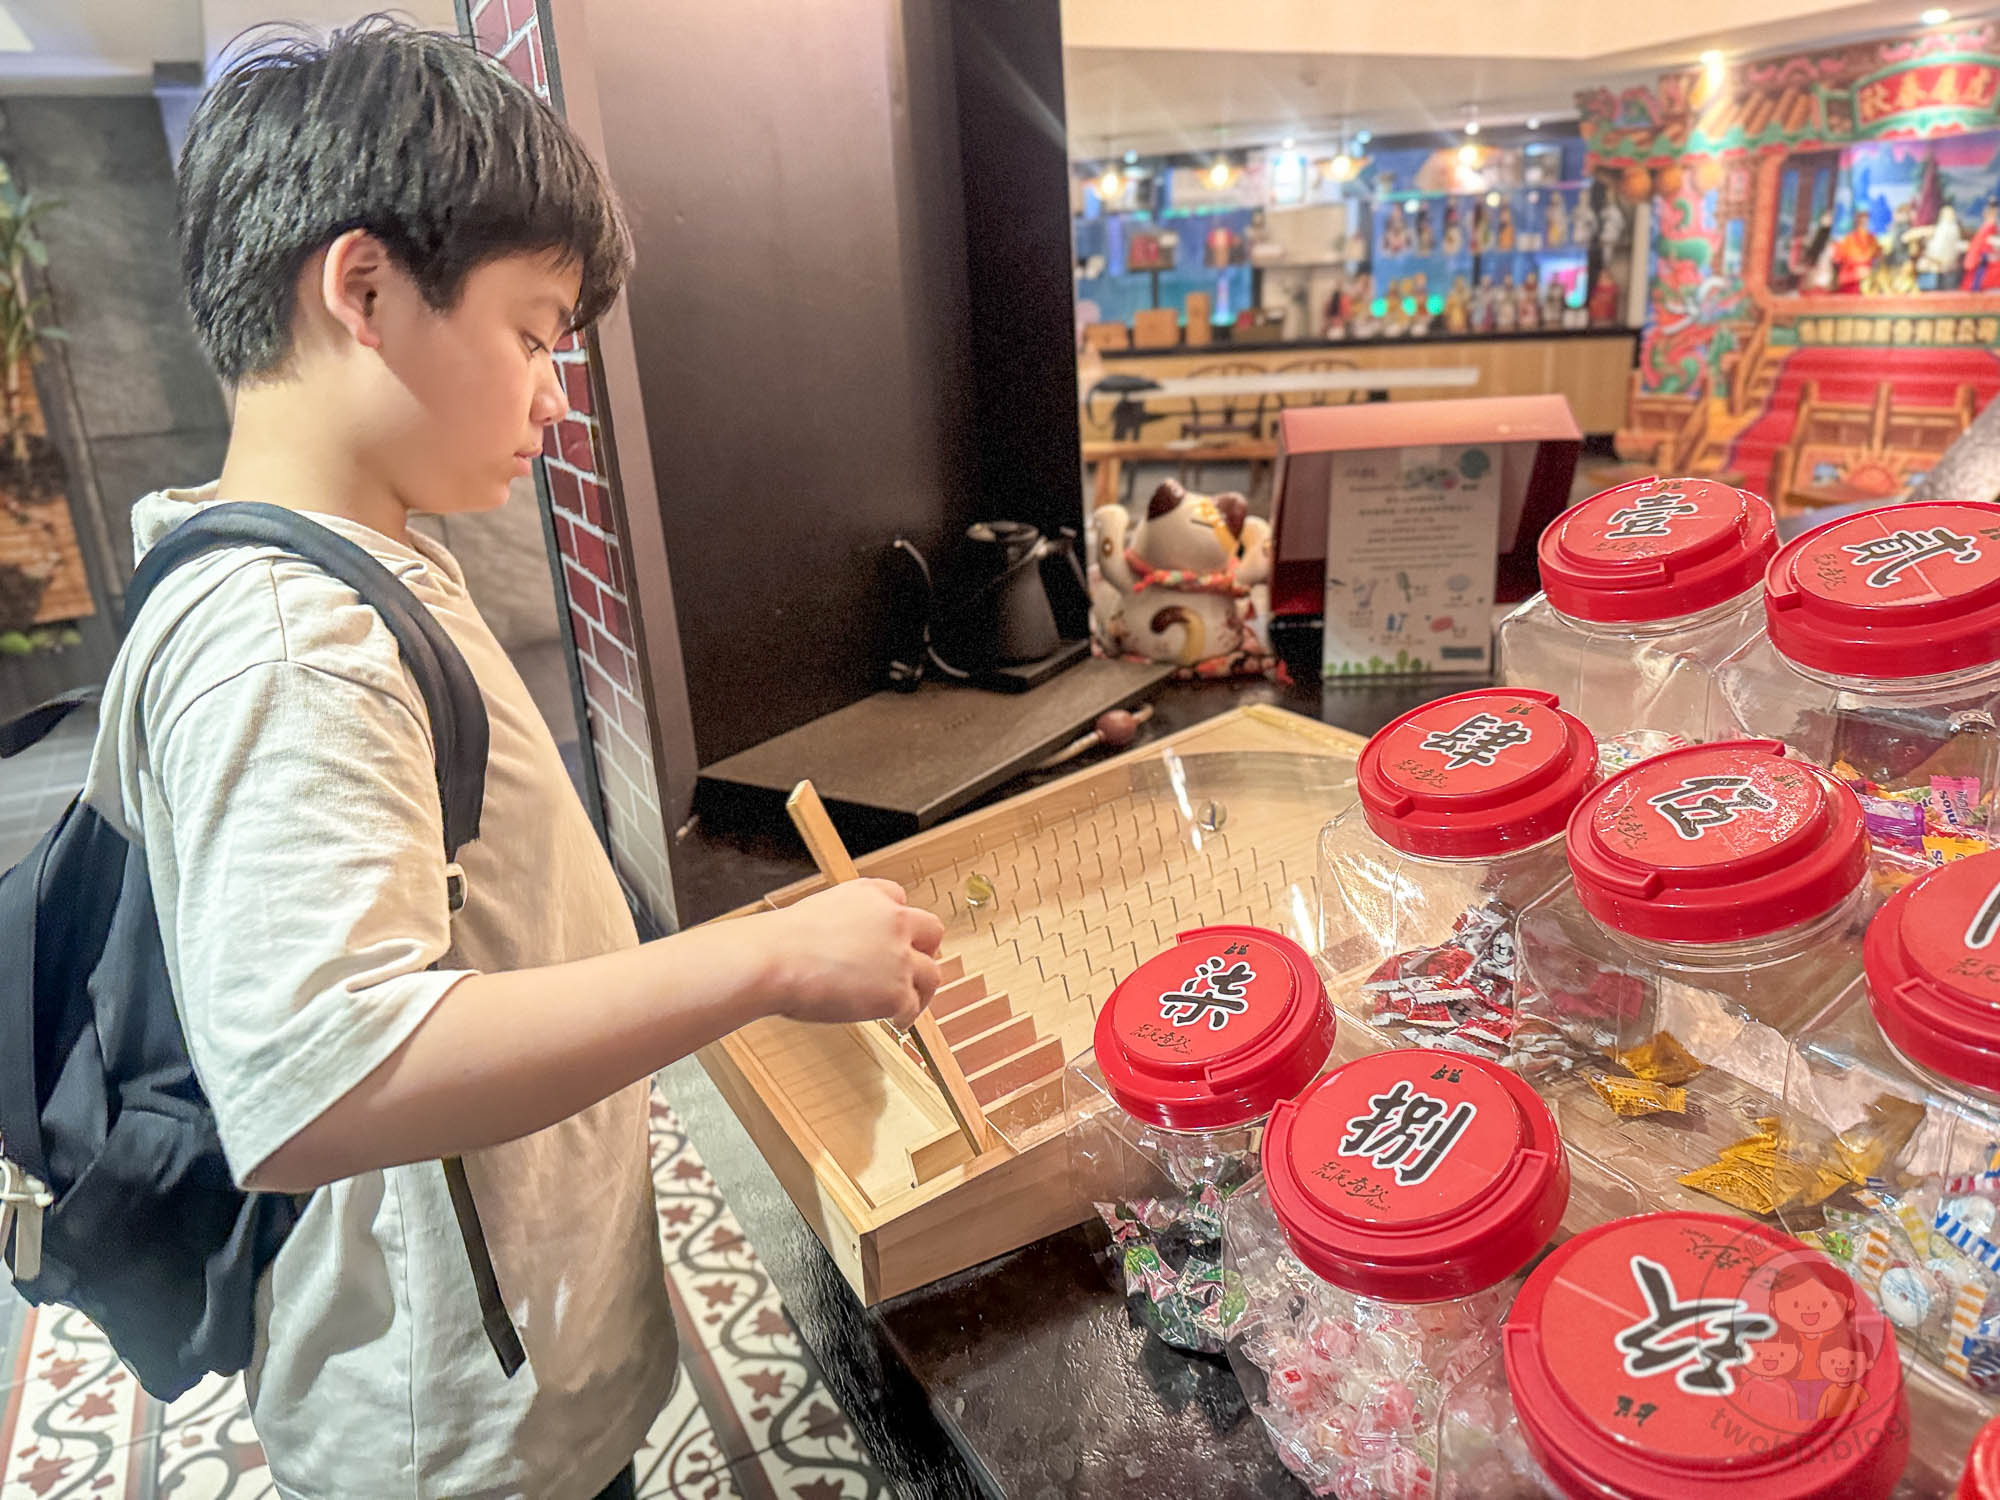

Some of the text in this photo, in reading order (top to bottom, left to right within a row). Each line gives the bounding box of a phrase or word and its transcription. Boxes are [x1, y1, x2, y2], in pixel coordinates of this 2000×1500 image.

[1605, 493, 1697, 539] 壹
[1420, 713, 1531, 770] 肆
[1648, 776, 1777, 840] 伍
[1159, 956, 1256, 1030] 柒
[1339, 1081, 1476, 1185] 捌
